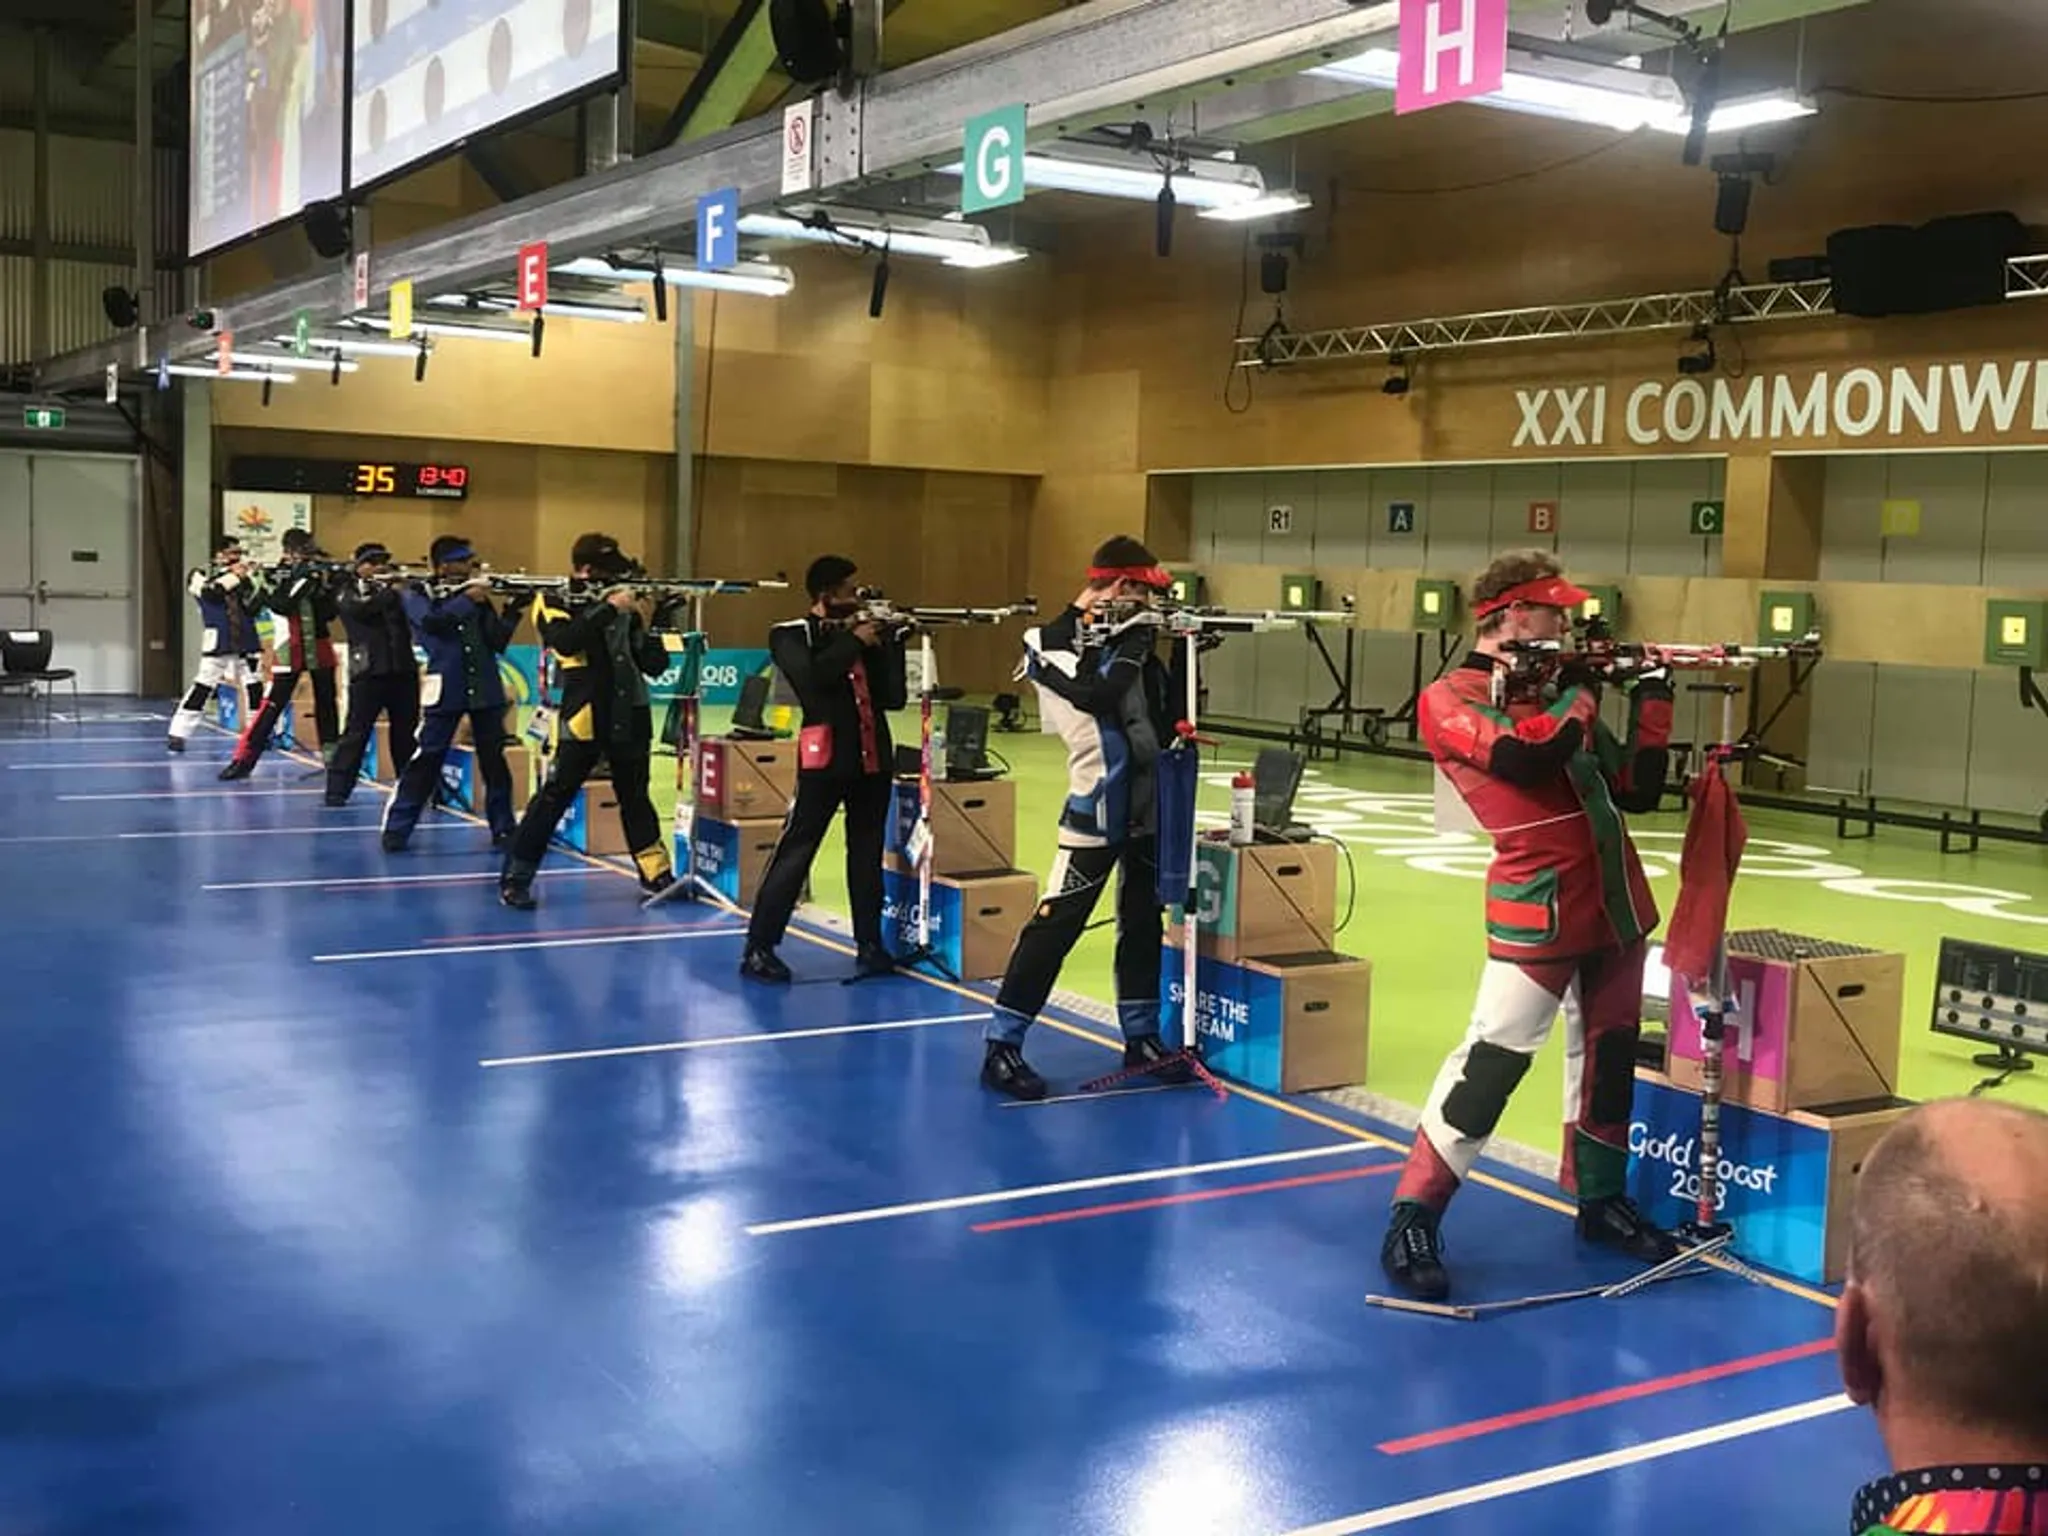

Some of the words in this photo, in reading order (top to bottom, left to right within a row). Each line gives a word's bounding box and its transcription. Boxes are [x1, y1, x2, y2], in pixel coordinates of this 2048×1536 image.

[1422, 0, 1476, 94] H
[976, 125, 1012, 199] G
[705, 203, 724, 263] F
[524, 255, 540, 303] E
[1511, 386, 1606, 447] XXI
[355, 464, 395, 493] 35
[1270, 509, 1291, 531] R1
[1393, 508, 1408, 532] A
[1535, 507, 1550, 531] B
[1698, 507, 1716, 531] C
[700, 665, 738, 687] 018
[701, 751, 717, 798] E
[1196, 859, 1221, 923] G
[1168, 981, 1218, 1015] SRE
[1219, 995, 1250, 1026] THE
[1195, 1011, 1235, 1043] REAM
[1628, 1121, 1694, 1170] Gold
[1716, 1146, 1778, 1195] oast
[1669, 1169, 1728, 1212] 208
